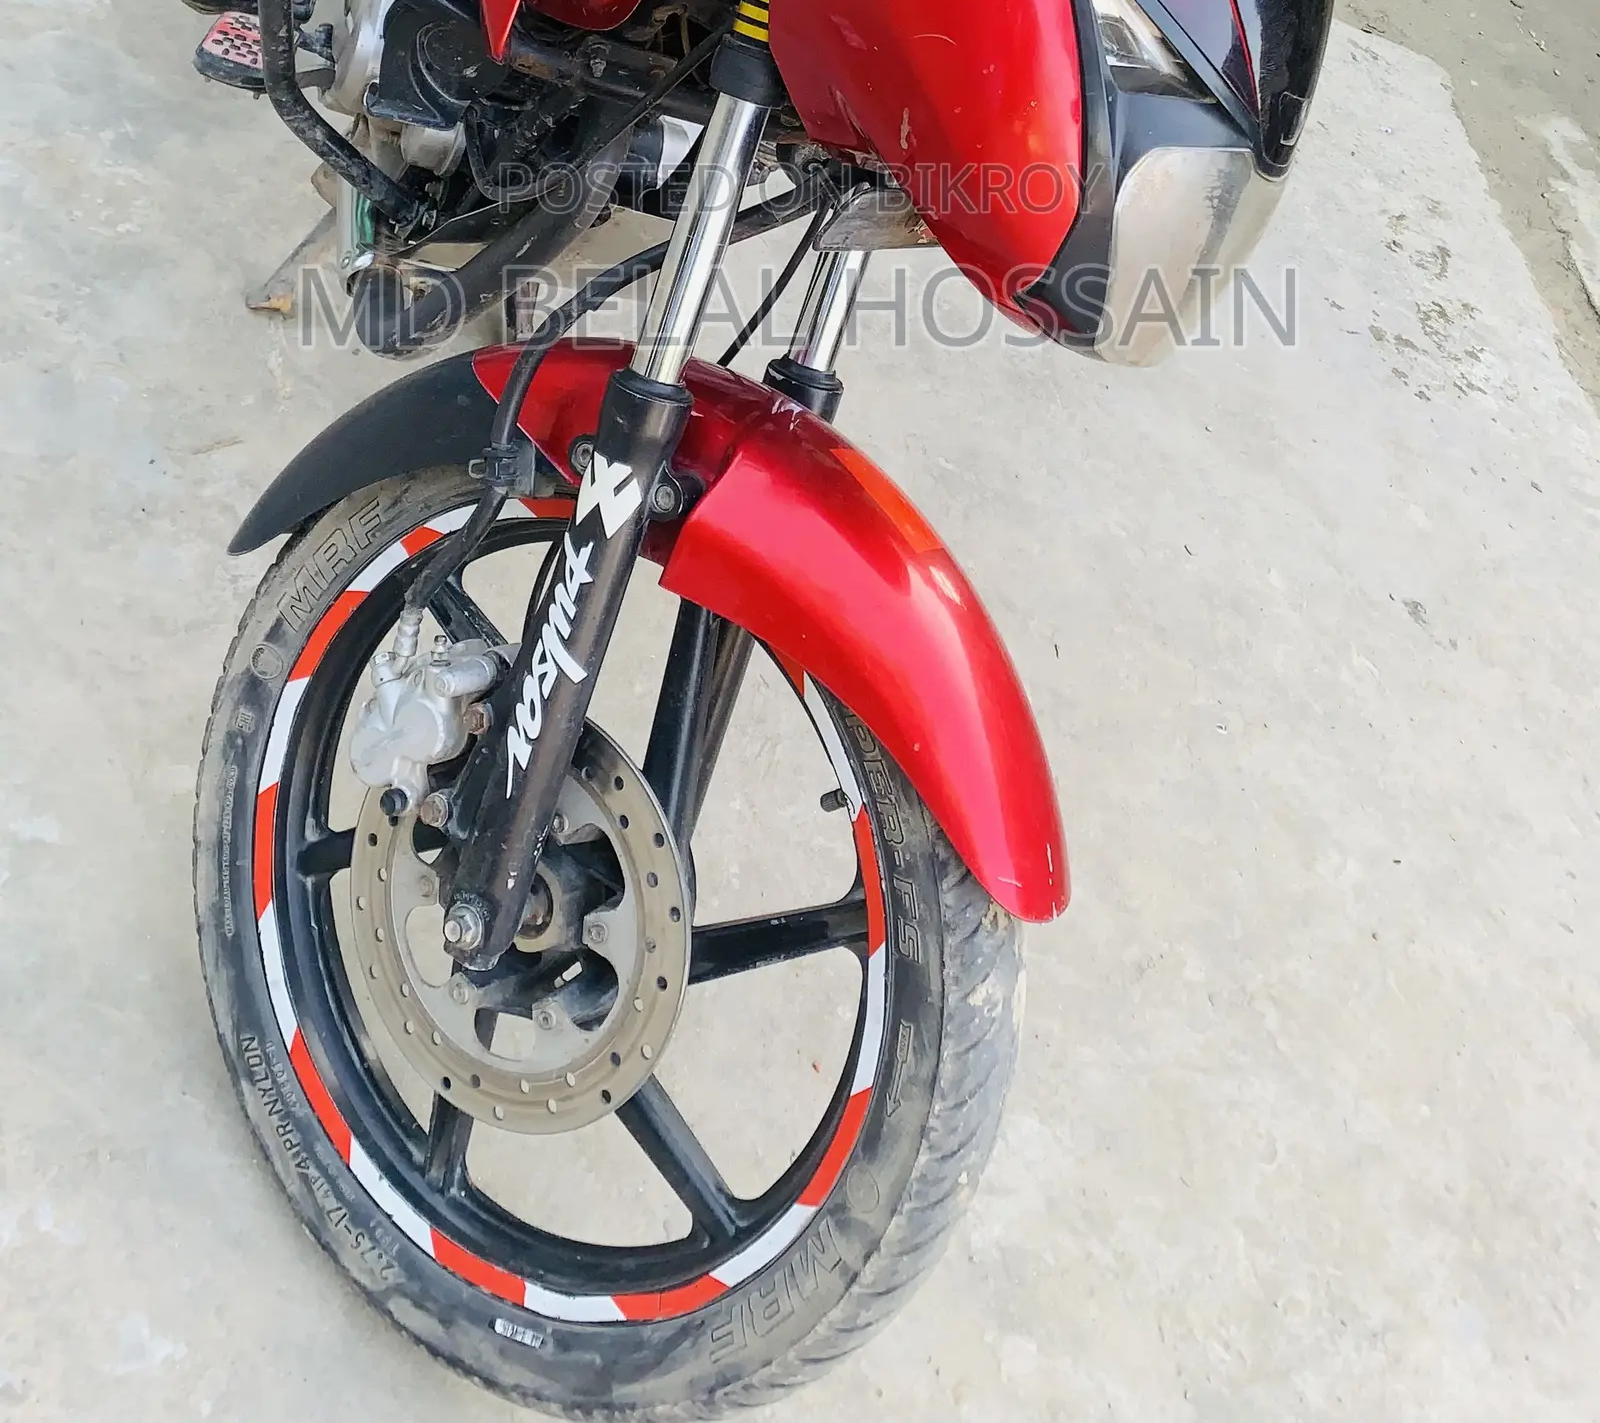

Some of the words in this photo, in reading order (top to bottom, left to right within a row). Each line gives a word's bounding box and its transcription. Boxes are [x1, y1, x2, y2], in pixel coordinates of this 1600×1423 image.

[276, 497, 383, 633] MRF
[845, 711, 922, 965] PER-FS
[241, 1035, 284, 1118] NYLON
[710, 1216, 842, 1364] MRF
